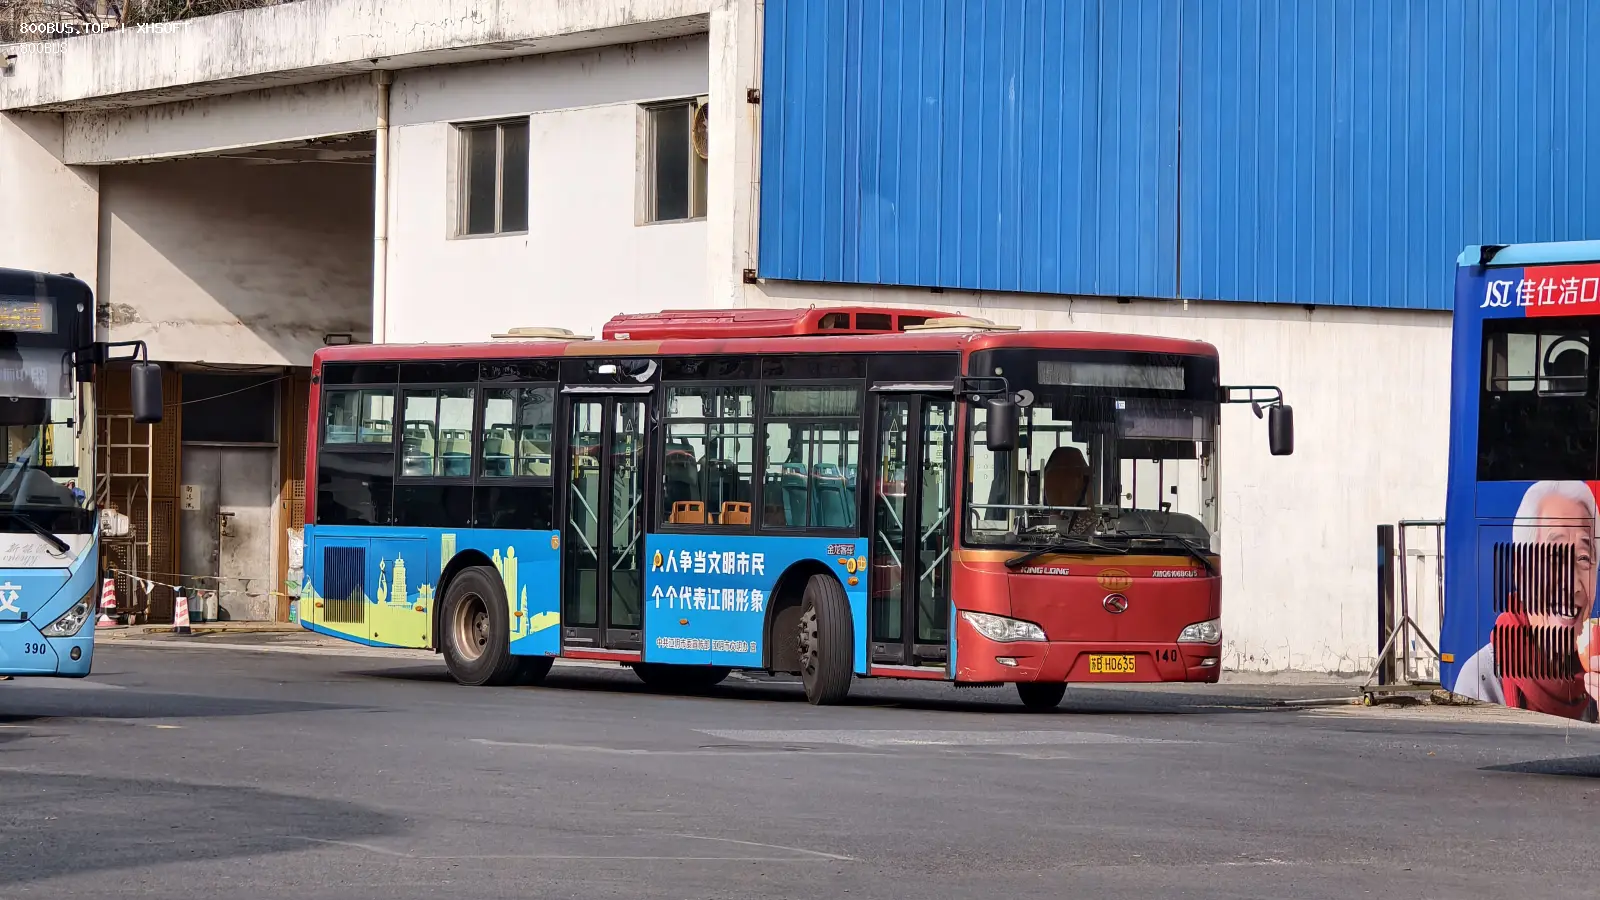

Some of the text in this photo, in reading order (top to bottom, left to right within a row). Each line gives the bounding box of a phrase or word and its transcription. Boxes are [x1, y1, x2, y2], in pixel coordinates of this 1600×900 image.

[1480, 280, 1513, 308] JST
[651, 585, 764, 613] 个个代表江阴形象
[24, 642, 46, 655] 390
[1155, 649, 1177, 662] 140
